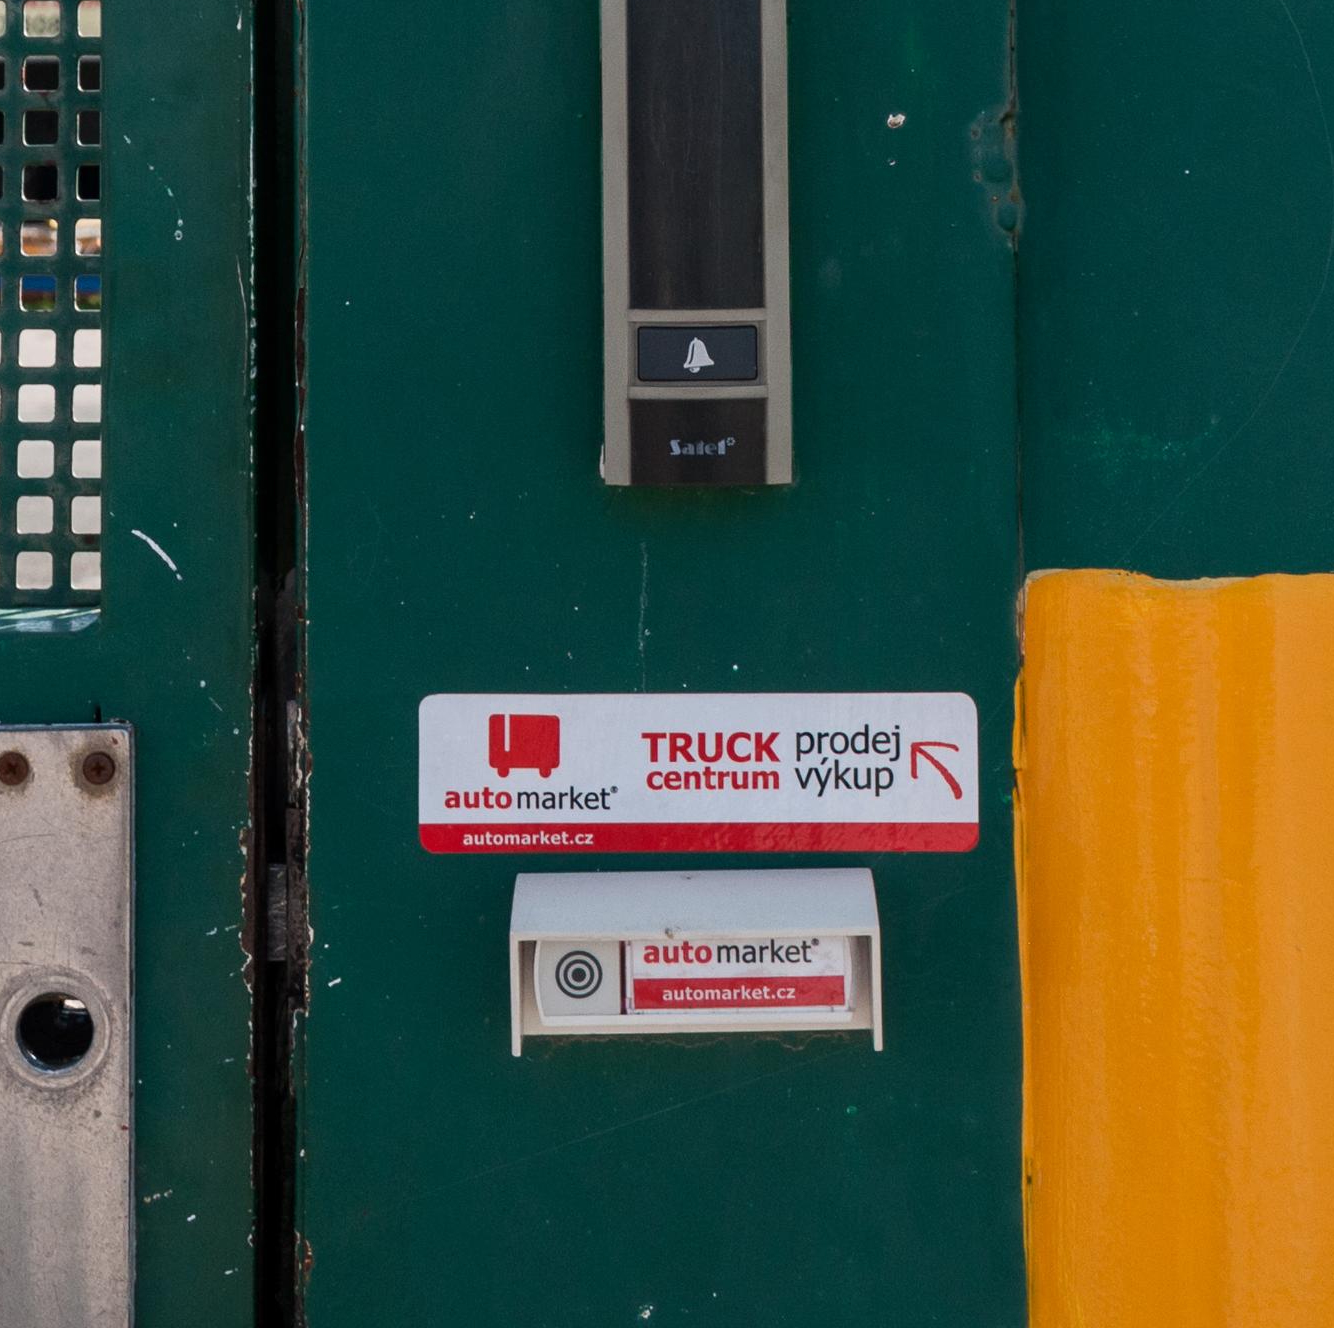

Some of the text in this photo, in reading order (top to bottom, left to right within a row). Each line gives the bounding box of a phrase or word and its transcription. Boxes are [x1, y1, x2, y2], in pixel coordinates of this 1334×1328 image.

[641, 732, 781, 763] TRUCK
[795, 724, 901, 761] prodej
[646, 766, 780, 790] centrum
[794, 757, 894, 797] výkup
[463, 831, 594, 846] automarket.cz
[662, 985, 796, 1002] automarket.cz
